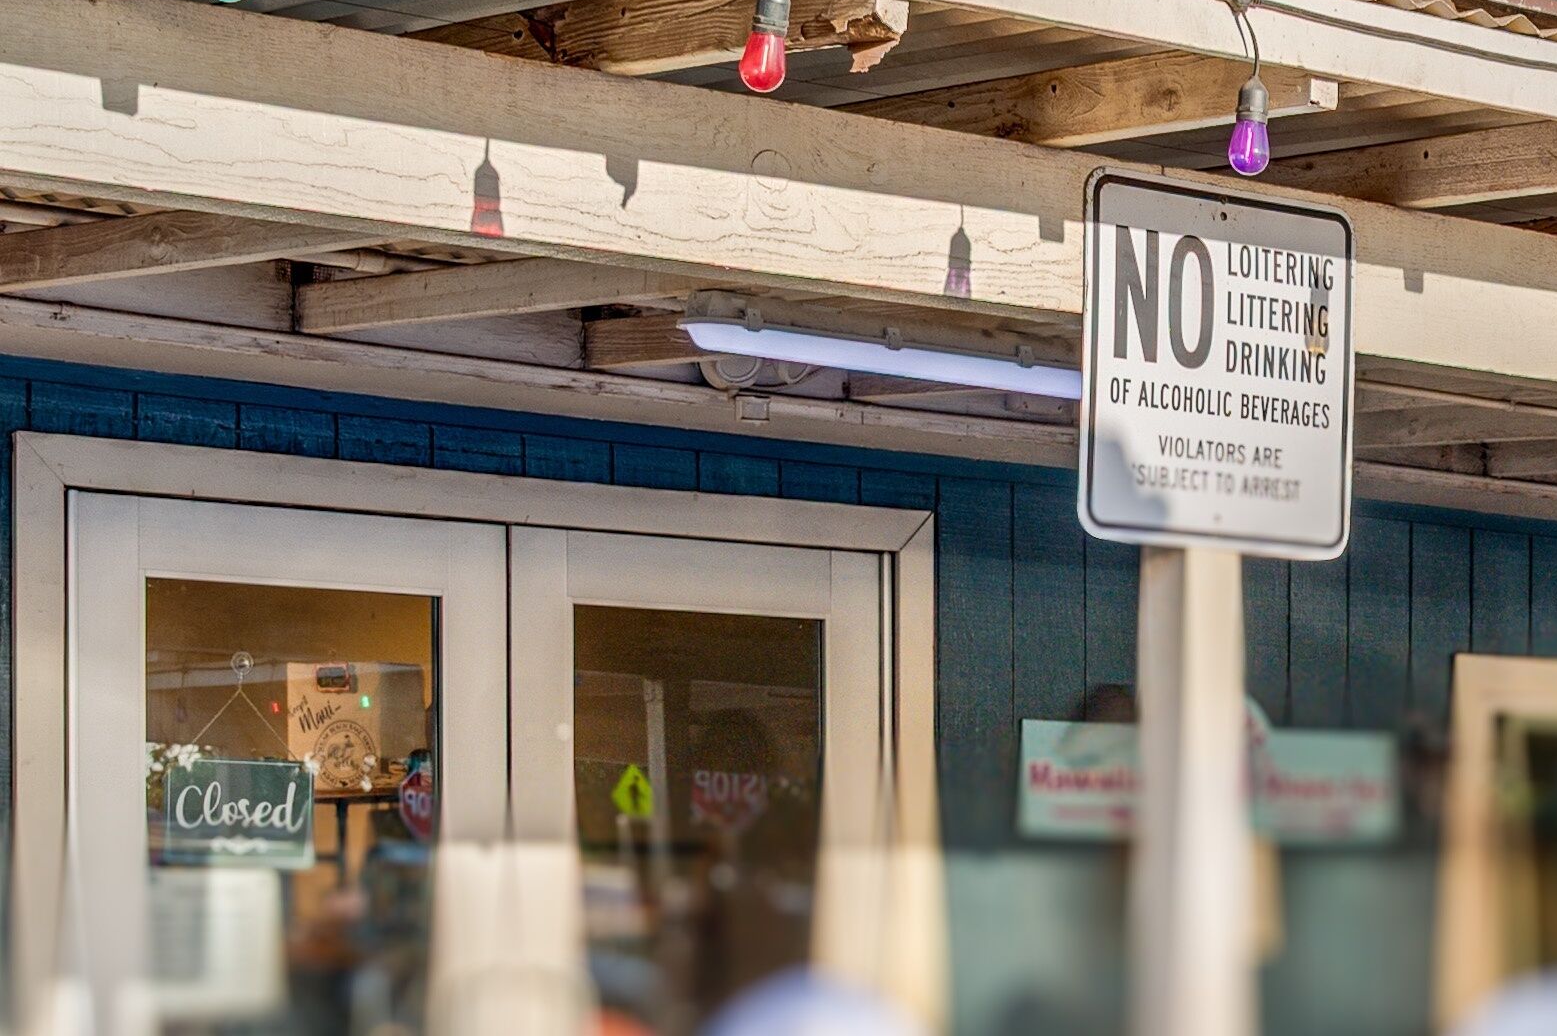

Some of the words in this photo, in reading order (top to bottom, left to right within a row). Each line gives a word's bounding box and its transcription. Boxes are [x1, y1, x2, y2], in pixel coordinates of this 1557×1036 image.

[1227, 242, 1334, 291] LOITERING
[1113, 224, 1215, 370] NO
[1226, 290, 1329, 338] LITTERING
[1225, 339, 1327, 385] DRINKING
[1110, 377, 1132, 406] OF
[1137, 380, 1232, 418] ALCOHOLIC
[1240, 393, 1330, 429] BEVERAGES
[1158, 434, 1246, 465] VIOLATORS
[1252, 446, 1283, 469] ARE
[1135, 463, 1210, 492] SUBJECT
[1215, 471, 1235, 495] TO
[1239, 475, 1302, 502] ARREST
[175, 780, 308, 834] Closed
